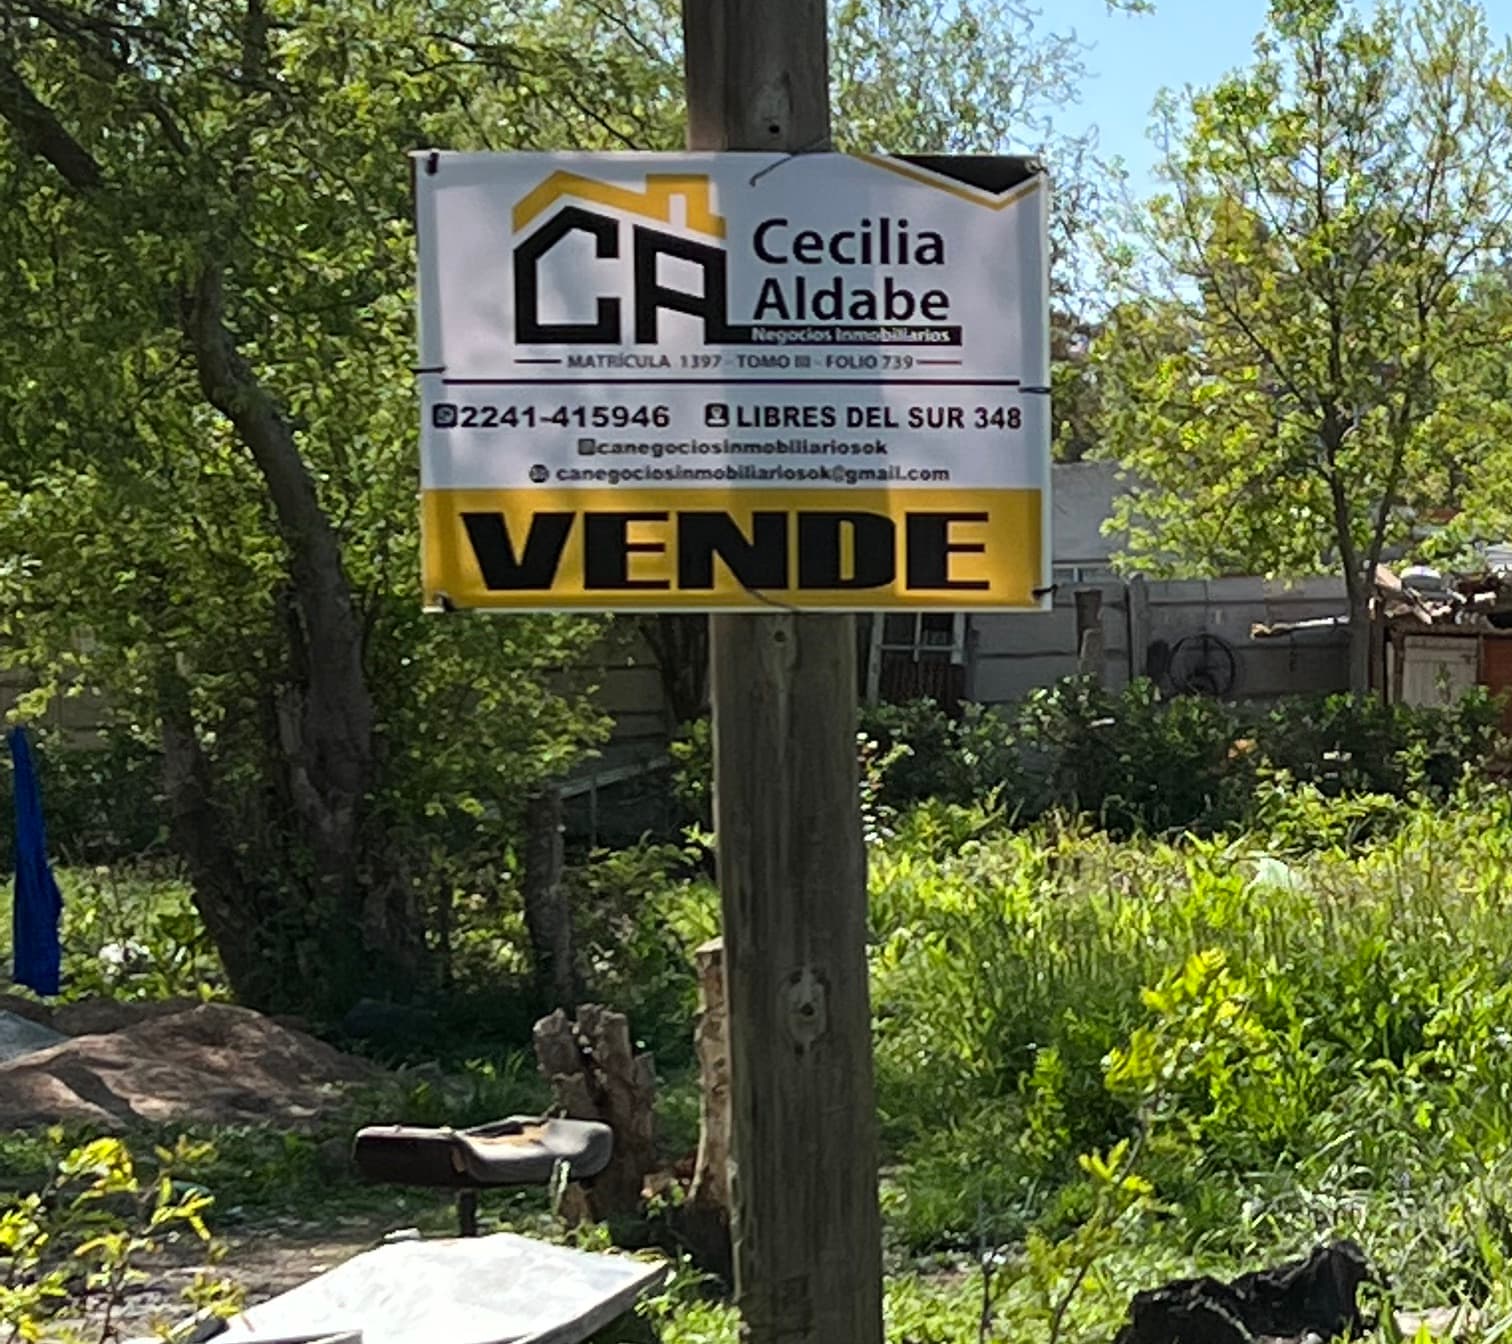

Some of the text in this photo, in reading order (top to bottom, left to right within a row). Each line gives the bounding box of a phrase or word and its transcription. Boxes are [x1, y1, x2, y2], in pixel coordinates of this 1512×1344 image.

[752, 217, 946, 266] Cecilia
[754, 276, 950, 321] Aldabe
[751, 325, 951, 344] Negocios Inmobiliarios
[567, 352, 671, 369] MATRÍCULA
[680, 354, 722, 369] 1397
[736, 354, 790, 369] TOMO
[825, 354, 877, 369] FOLIO
[882, 354, 914, 370] 739
[460, 404, 671, 429] 2241-415946
[737, 406, 1022, 430] LIBRES DEL SUR 348
[597, 438, 888, 457] canegociosinmobiliariosok
[556, 464, 950, 485] canegociosinmobiliariosok@gmail.com
[459, 511, 991, 591] VENDE
